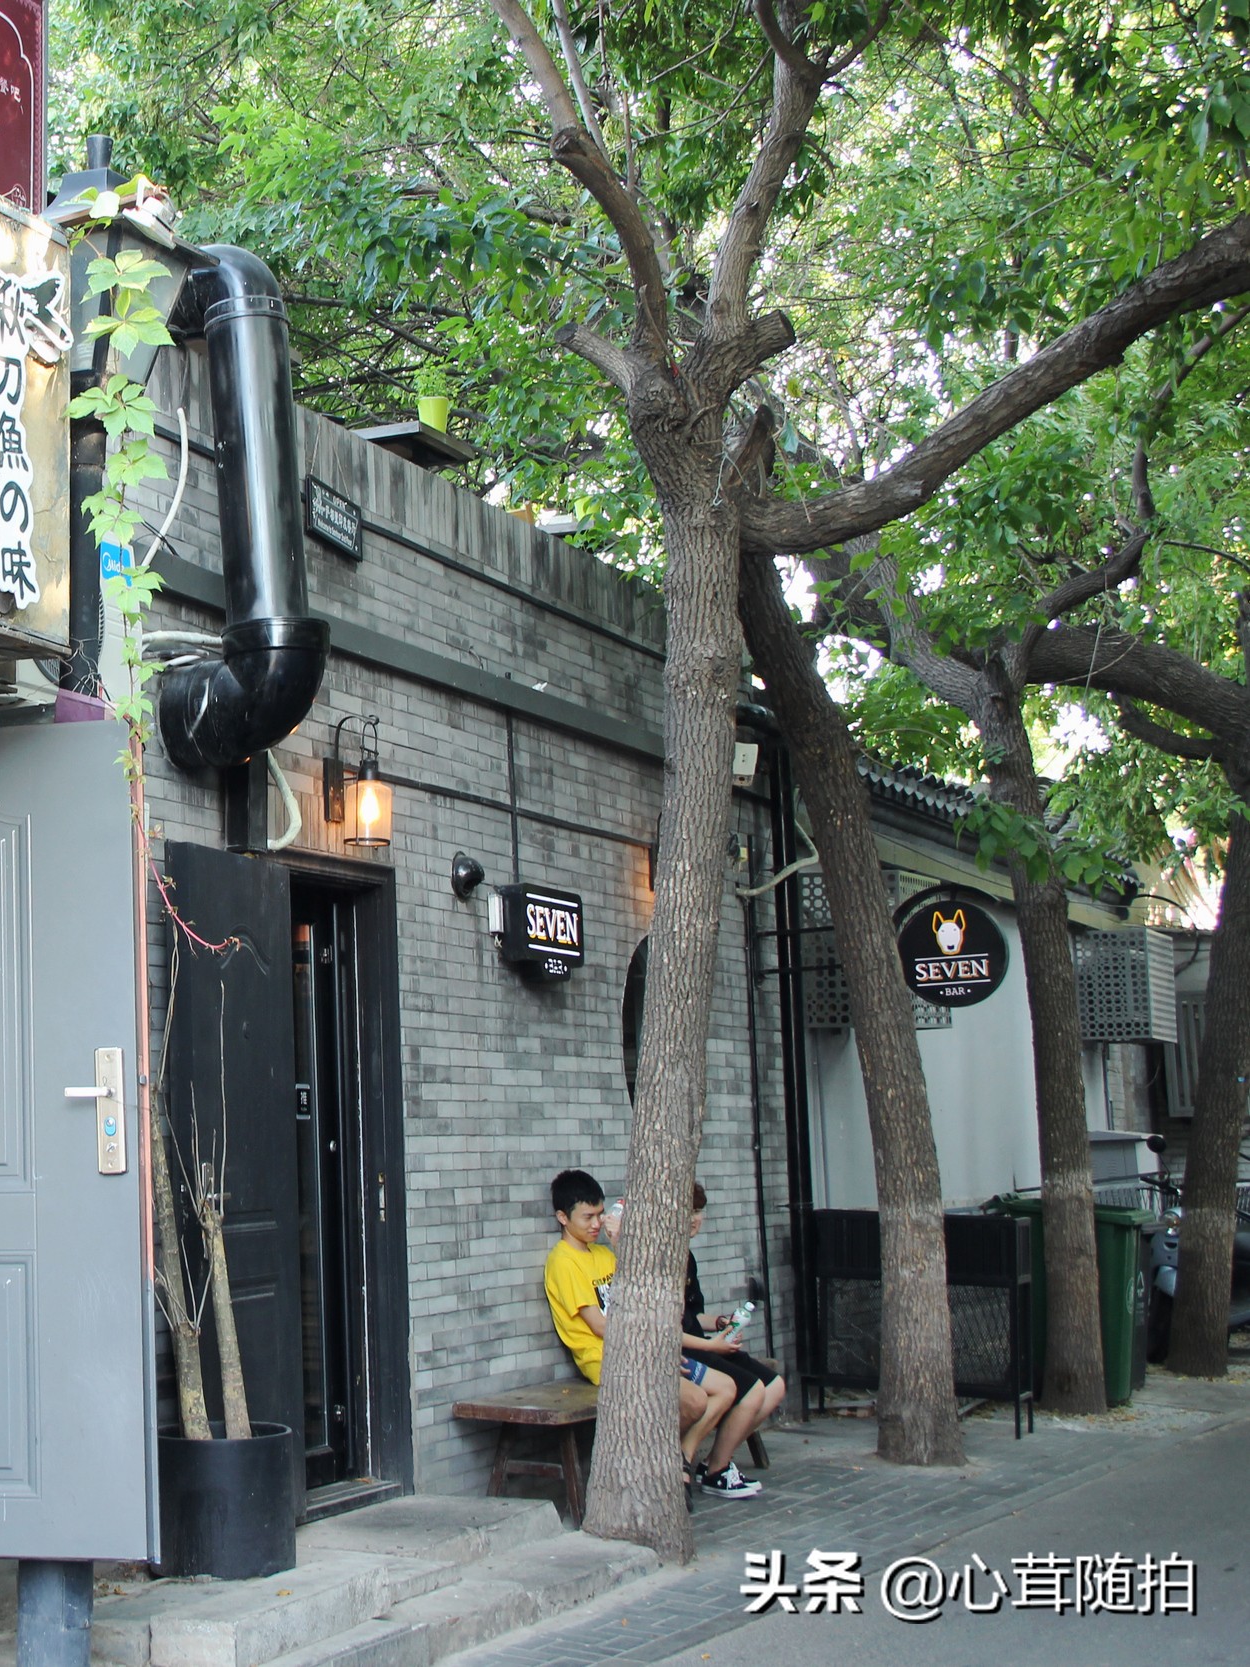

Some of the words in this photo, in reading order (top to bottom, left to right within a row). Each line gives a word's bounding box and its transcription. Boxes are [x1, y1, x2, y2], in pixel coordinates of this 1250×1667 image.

[526, 903, 579, 947] SEVEN
[914, 959, 989, 981] SEVEN
[945, 986, 966, 996] BAR
